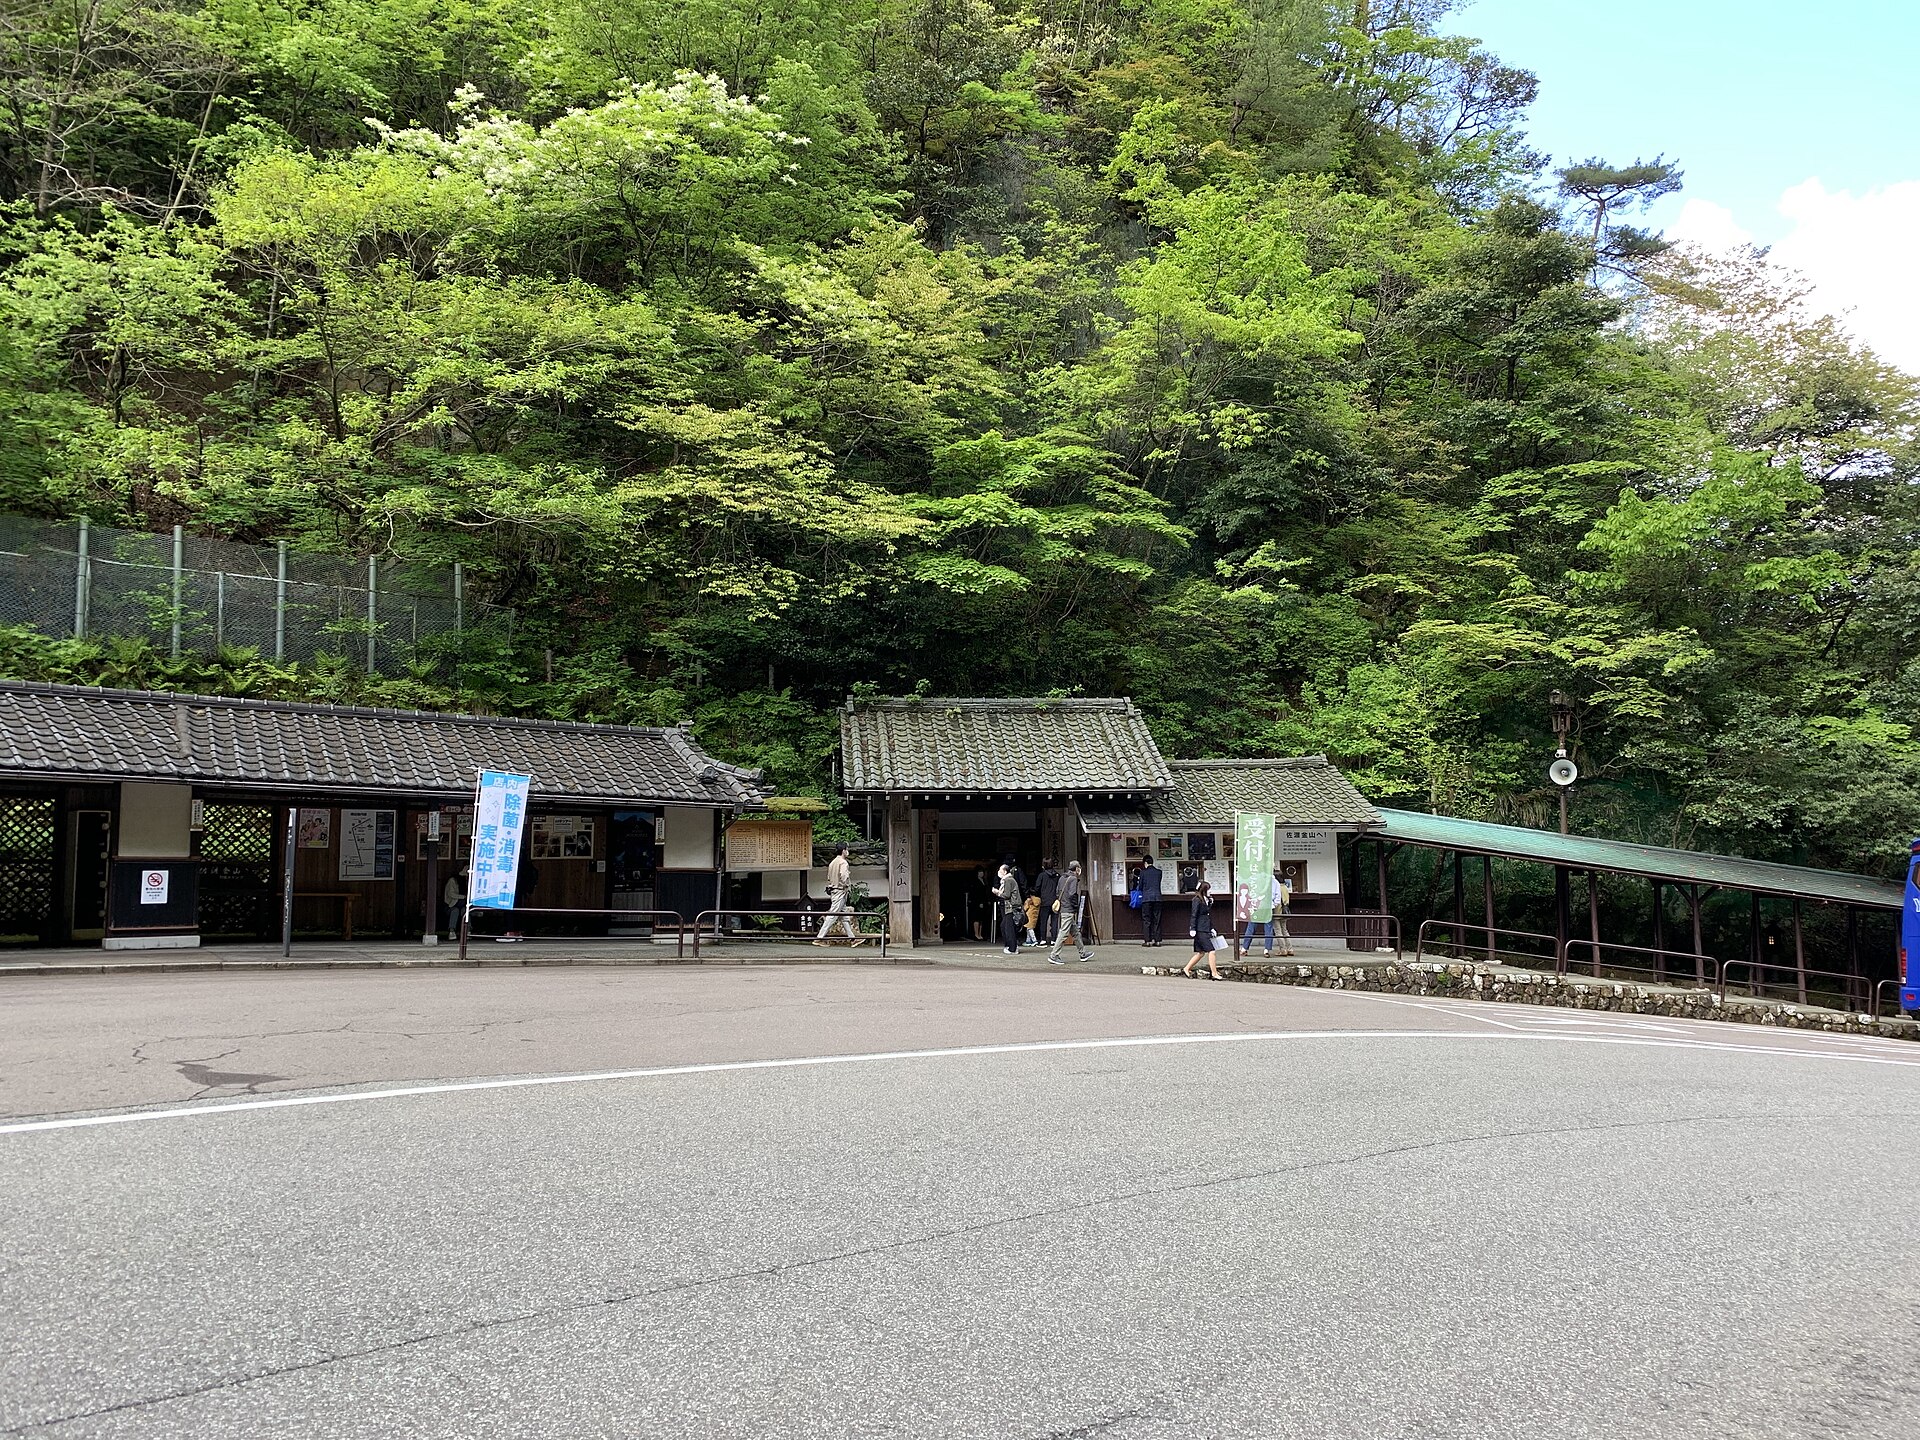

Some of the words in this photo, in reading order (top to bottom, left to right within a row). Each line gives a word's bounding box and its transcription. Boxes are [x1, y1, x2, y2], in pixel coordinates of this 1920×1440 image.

[493, 777, 518, 790] 店内
[496, 793, 522, 874] 除菌・消毒
